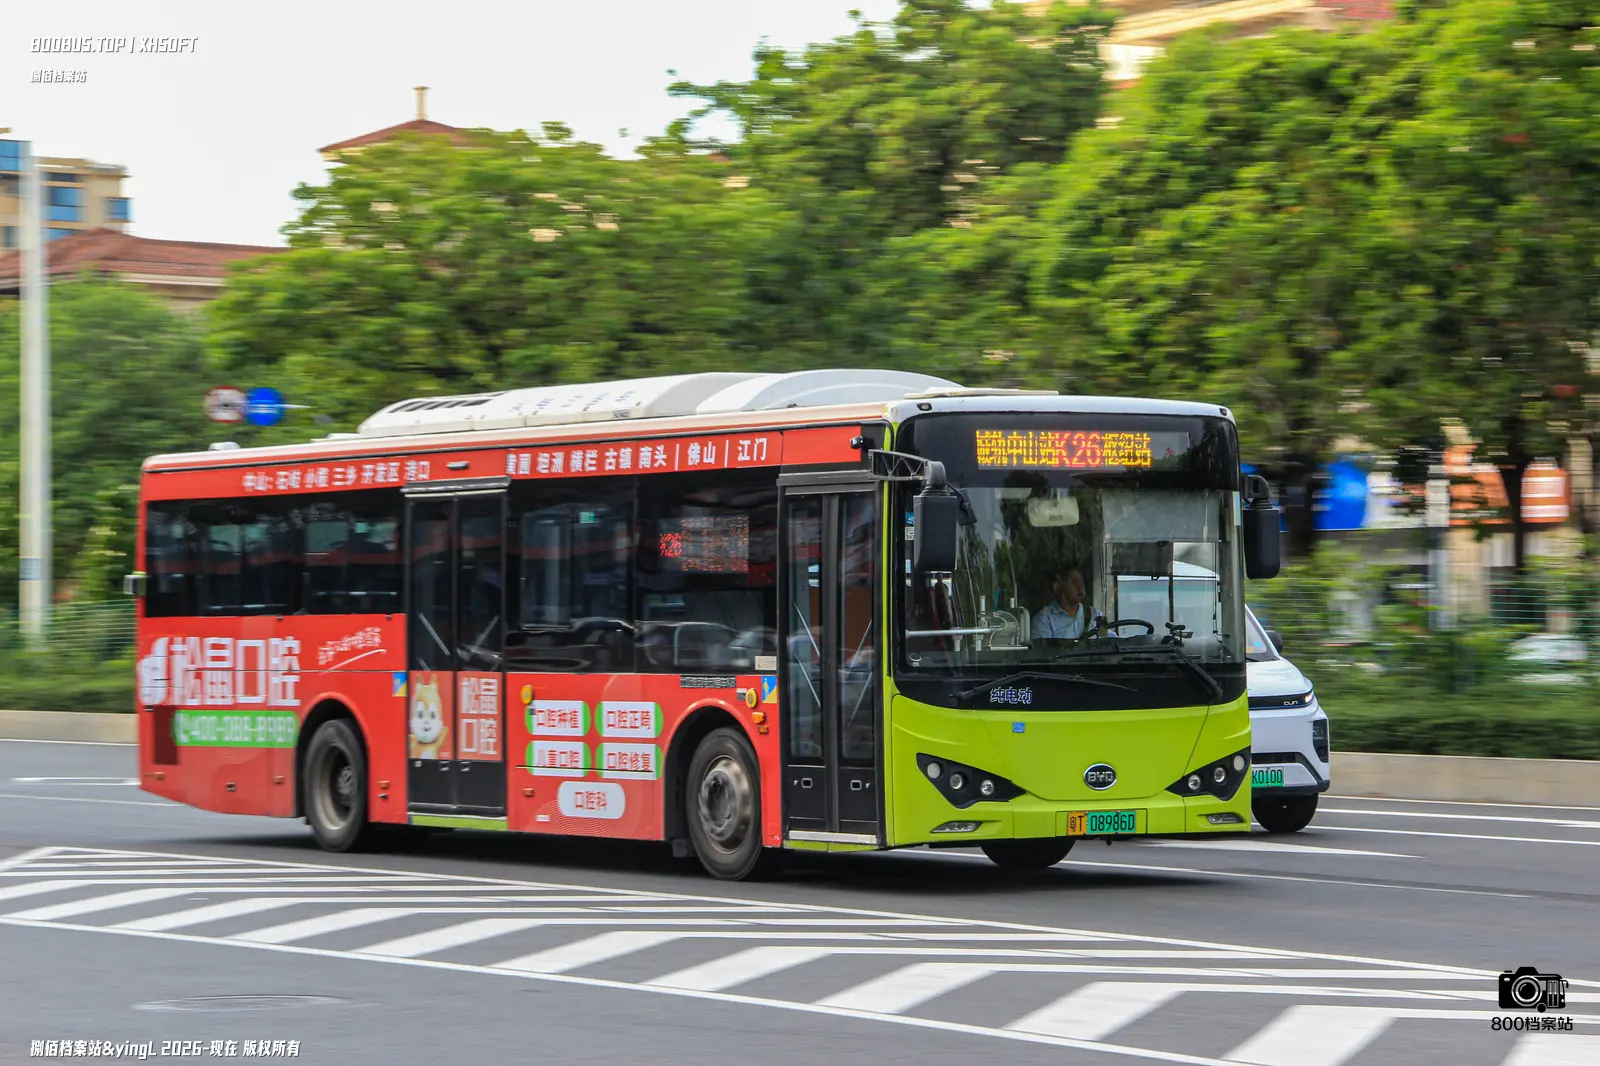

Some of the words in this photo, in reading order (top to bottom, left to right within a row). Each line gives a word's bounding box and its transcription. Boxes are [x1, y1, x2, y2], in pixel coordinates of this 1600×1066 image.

[536, 451, 565, 474] 坦洲
[570, 449, 598, 472] 横栏
[605, 447, 633, 470] 古镇
[639, 445, 667, 469] 南头
[687, 441, 716, 465] 佛山
[737, 438, 768, 462] 江门
[170, 636, 301, 706] 松晶口腔
[460, 677, 498, 714] 松晶
[990, 686, 1033, 704] 纯电动
[536, 709, 579, 728] 口腔种植
[607, 709, 651, 730] 口腔正畸
[461, 718, 498, 755] 口腔
[537, 749, 581, 769] 儿童口腔
[607, 751, 651, 771] 口腔修复
[1087, 771, 1113, 783] BYD
[574, 791, 607, 811] 口腔科
